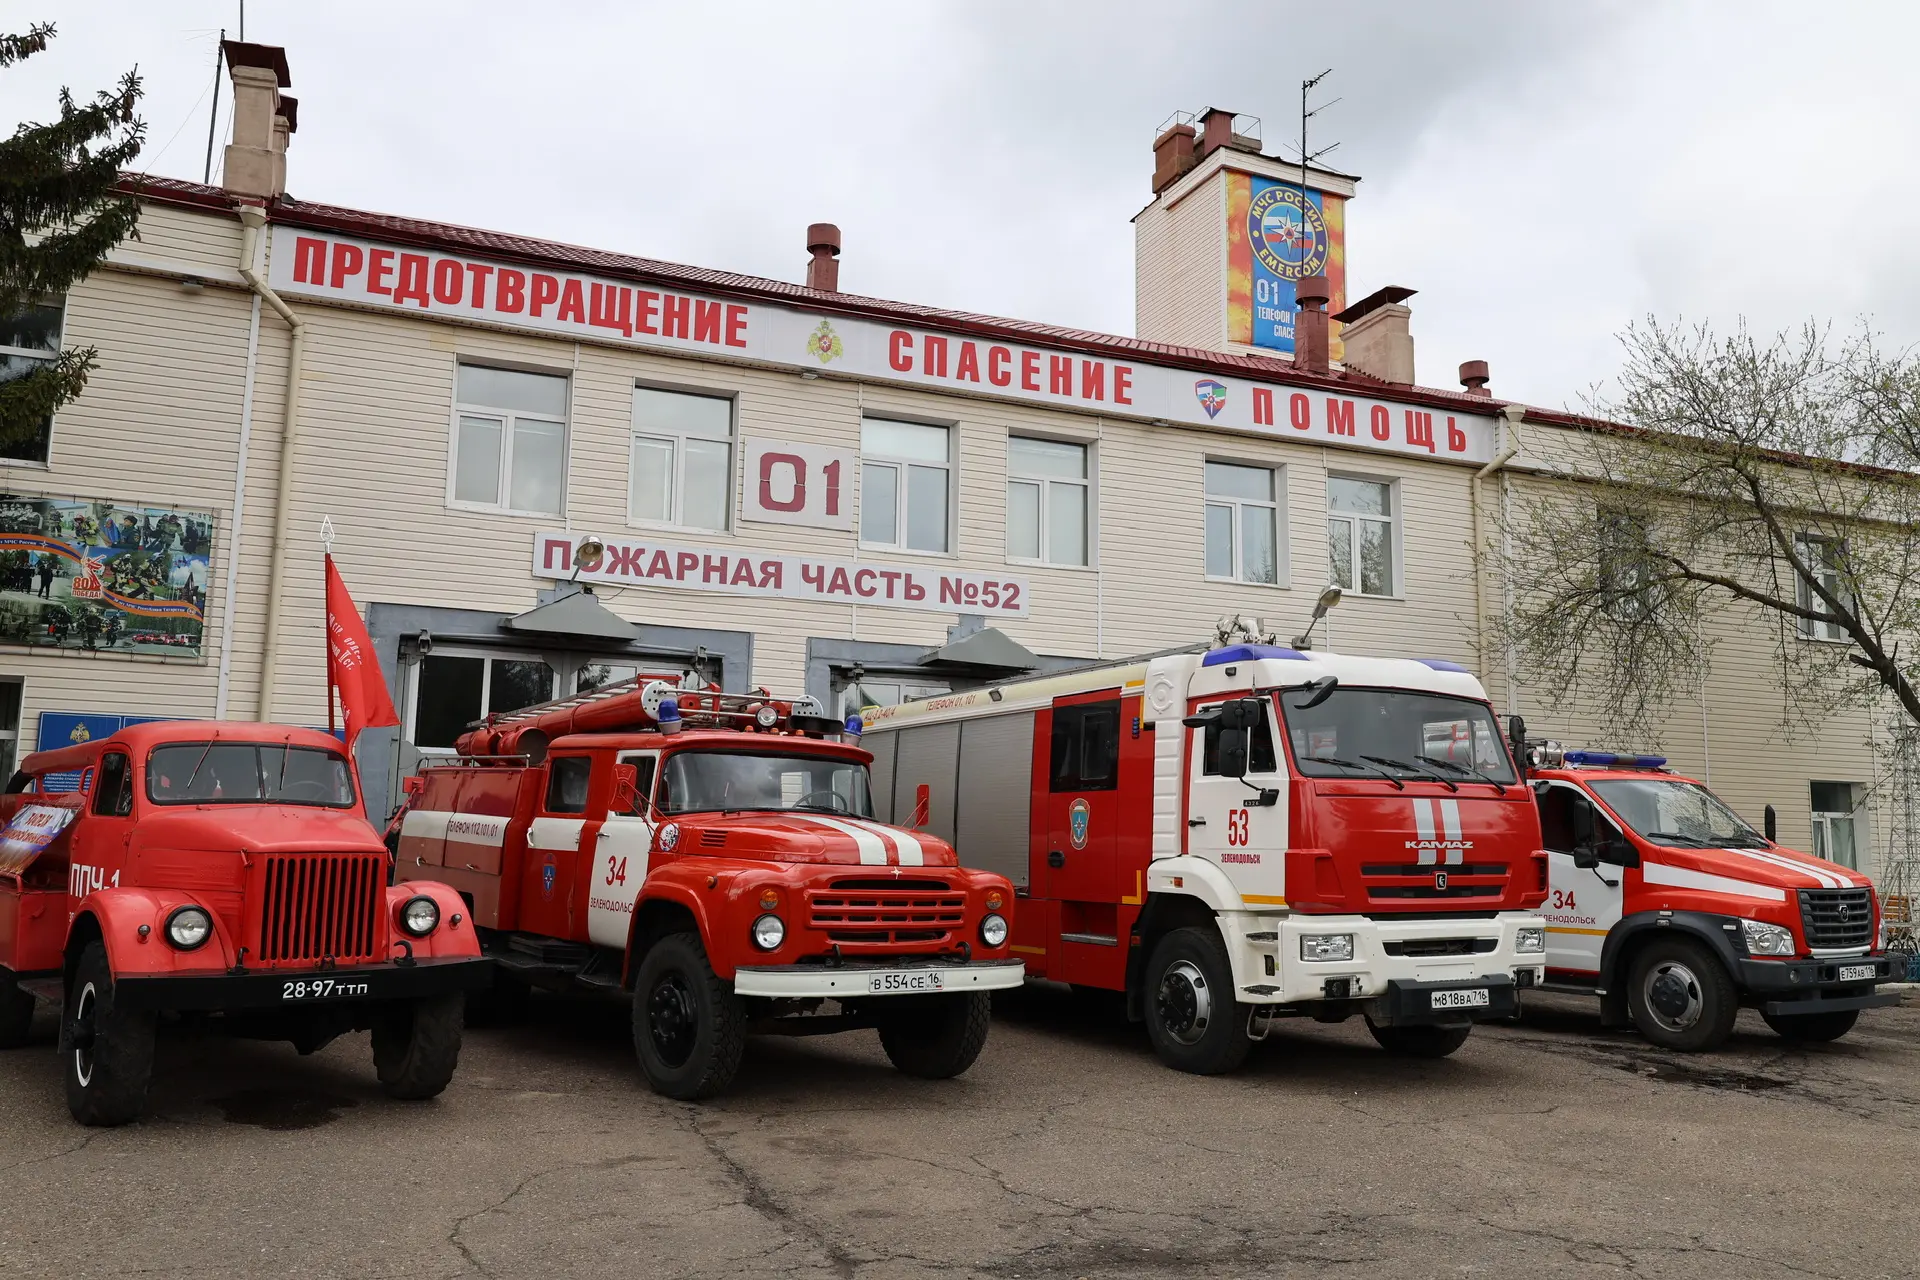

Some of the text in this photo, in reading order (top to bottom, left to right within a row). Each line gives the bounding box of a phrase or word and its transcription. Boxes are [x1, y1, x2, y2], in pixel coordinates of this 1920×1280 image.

[1252, 193, 1274, 219] МЧС
[1259, 248, 1320, 277] EMERCOM
[293, 236, 749, 348] ПРЕДОТВРАЩЕНИЕ
[1256, 278, 1279, 305] 01
[1257, 306, 1290, 325] ТЕЛЕФОН
[1274, 324, 1295, 340] СПАСЕ
[889, 330, 1133, 405] СПАСЕНИЕ
[1252, 387, 1467, 454] ПОМОЩЬ
[759, 452, 840, 516] 01
[73, 577, 89, 589] 80
[801, 564, 926, 601] ЧАСТЬ
[939, 577, 1020, 610] №52
[926, 699, 954, 711] ТЕЛЕФОН
[1228, 809, 1248, 846] 53
[1405, 841, 1473, 849] KAMAZ
[606, 855, 627, 887] 34
[1221, 853, 1260, 864] ЗЕЛЕНОДОЛЬСК
[590, 897, 634, 914] ЗЕЛЕНОДОЛЬС
[1552, 889, 1576, 910] 34
